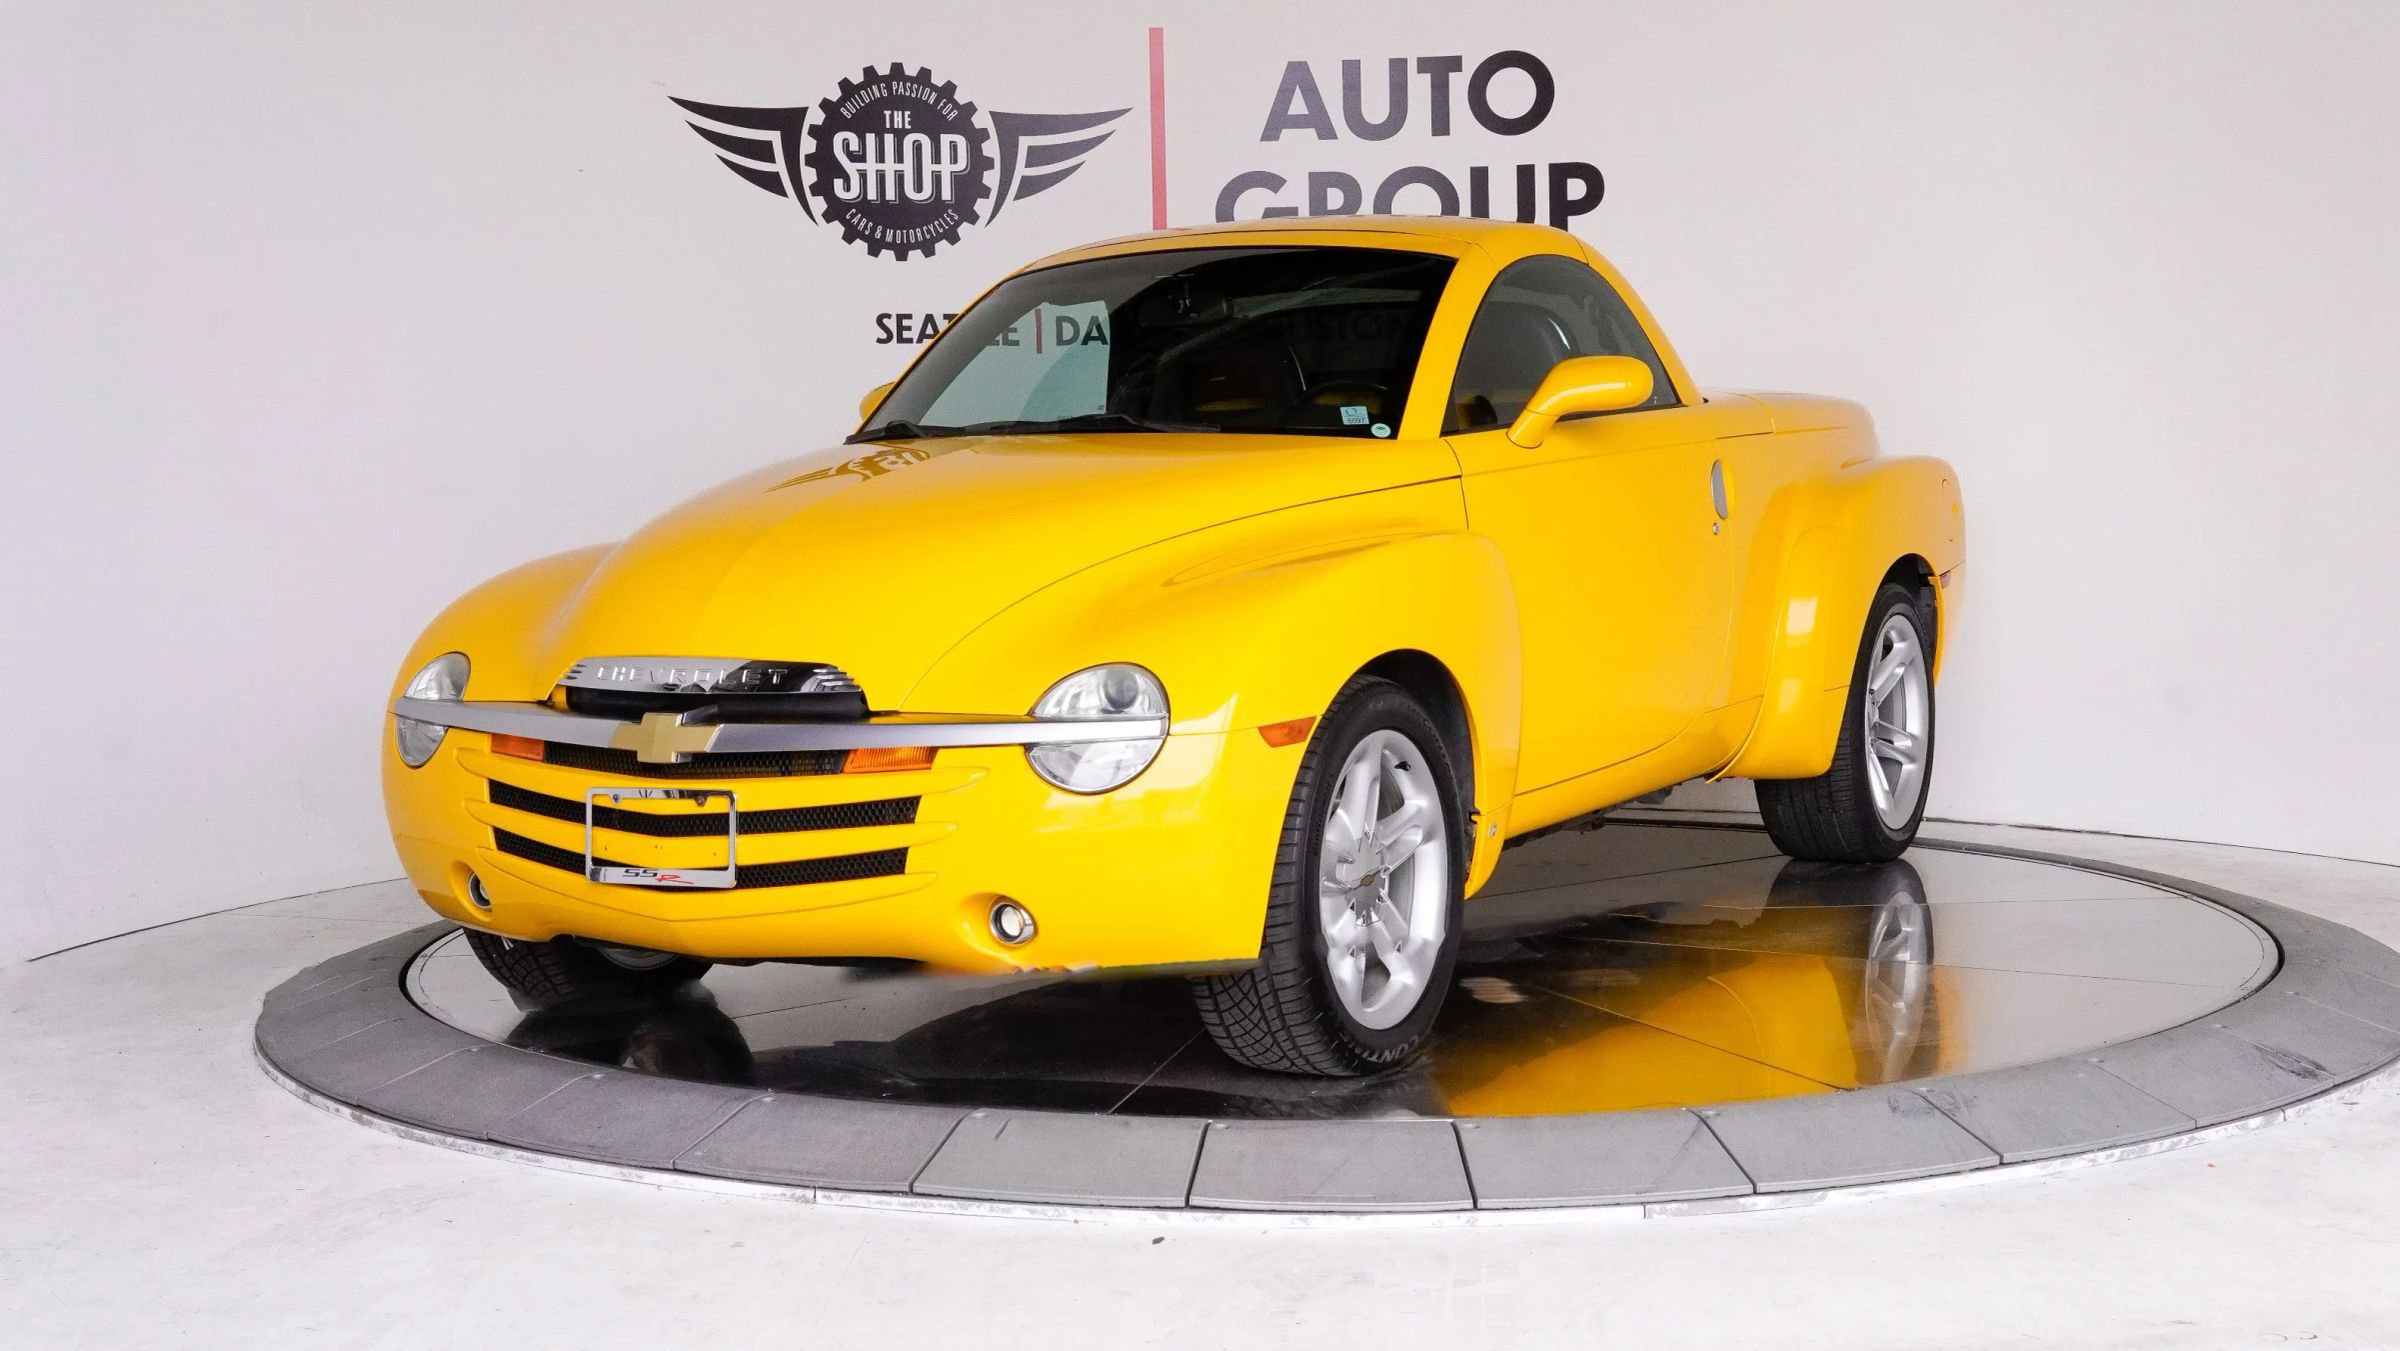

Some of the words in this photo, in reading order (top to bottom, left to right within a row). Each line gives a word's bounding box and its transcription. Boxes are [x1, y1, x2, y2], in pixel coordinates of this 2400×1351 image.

[840, 82, 888, 119] BUILDING
[892, 81, 938, 105] PASSION
[937, 98, 959, 122] FOR
[1260, 49, 1556, 142] AUTO
[883, 110, 912, 129] THE
[832, 130, 971, 204] SHOP
[1215, 161, 1605, 231] GROUP
[845, 208, 874, 235] CARS
[874, 225, 883, 239] &
[885, 208, 959, 244] MOTORCYCLES
[597, 665, 788, 686] CHEVROLET
[622, 867, 695, 885] SSR
